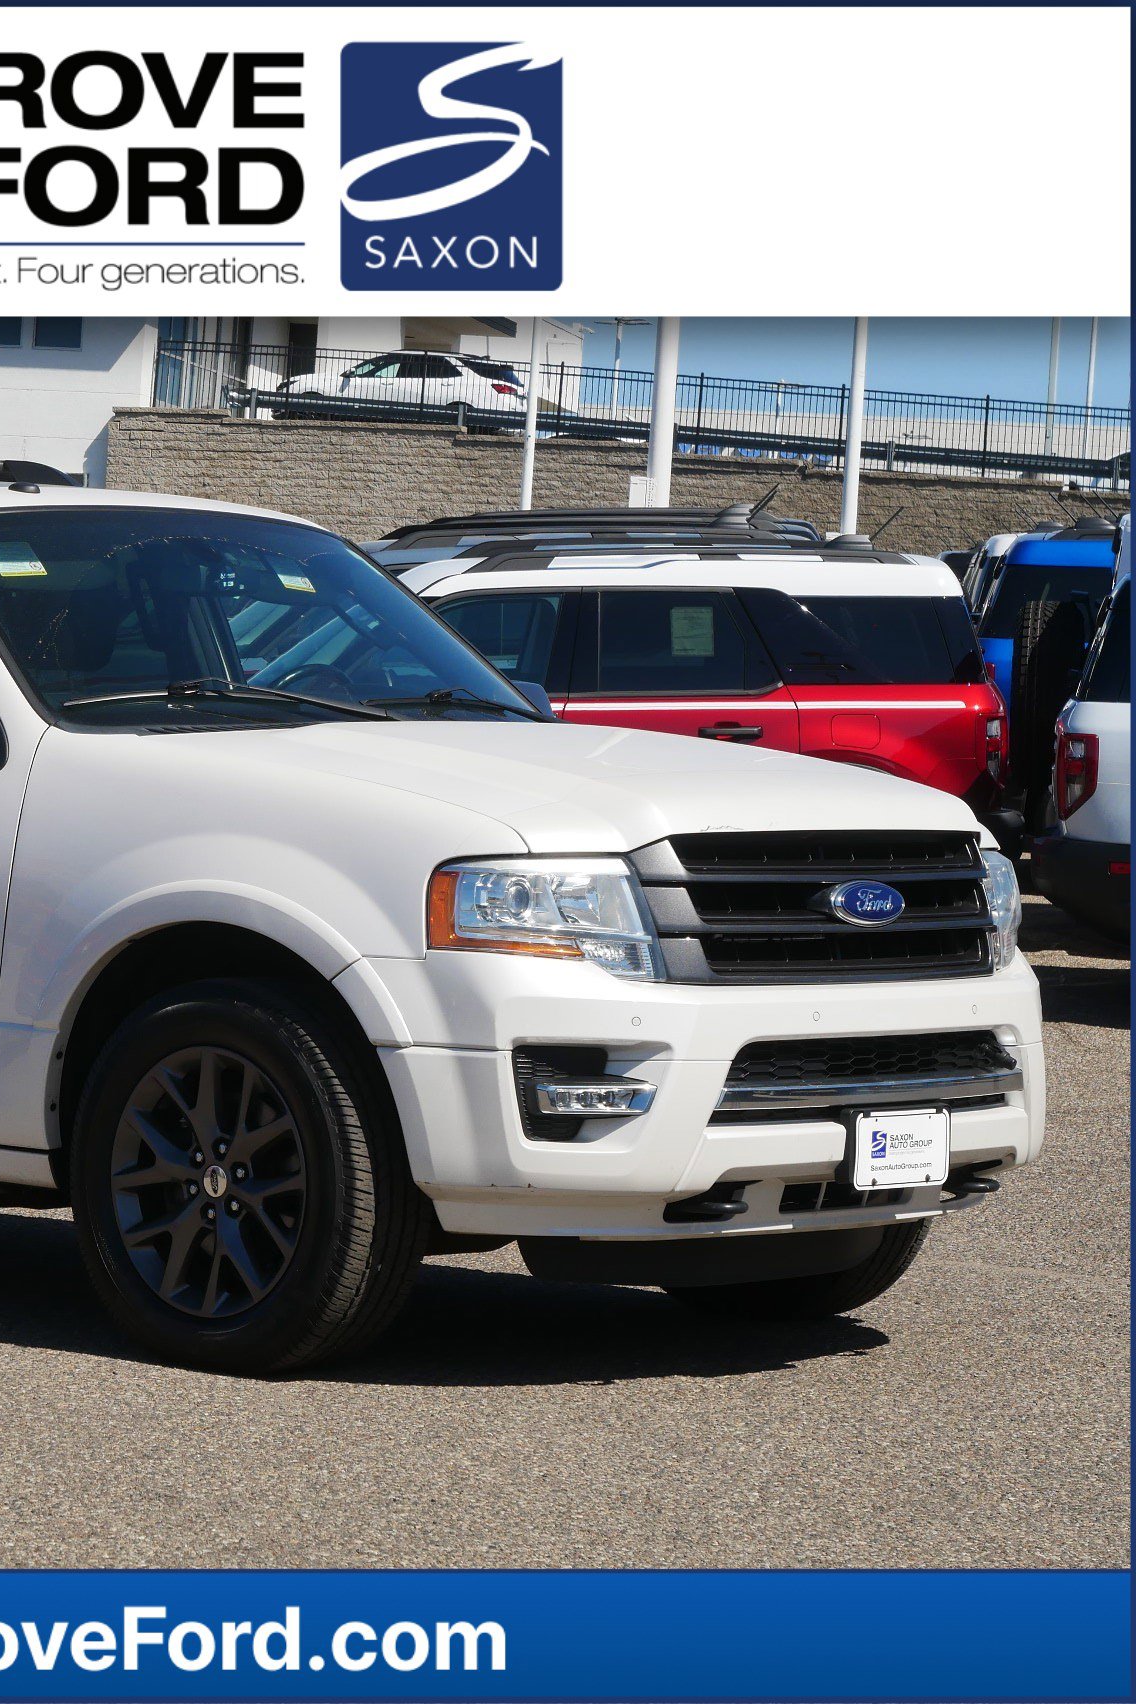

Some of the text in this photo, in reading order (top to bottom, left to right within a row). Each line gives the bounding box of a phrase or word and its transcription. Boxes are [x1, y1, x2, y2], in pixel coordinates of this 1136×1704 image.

[857, 888, 893, 913] Ford
[890, 1134, 914, 1142] SAXON
[890, 1140, 933, 1149] AUTO GROUP
[870, 1162, 933, 1171] SaxonAutoGroup.com
